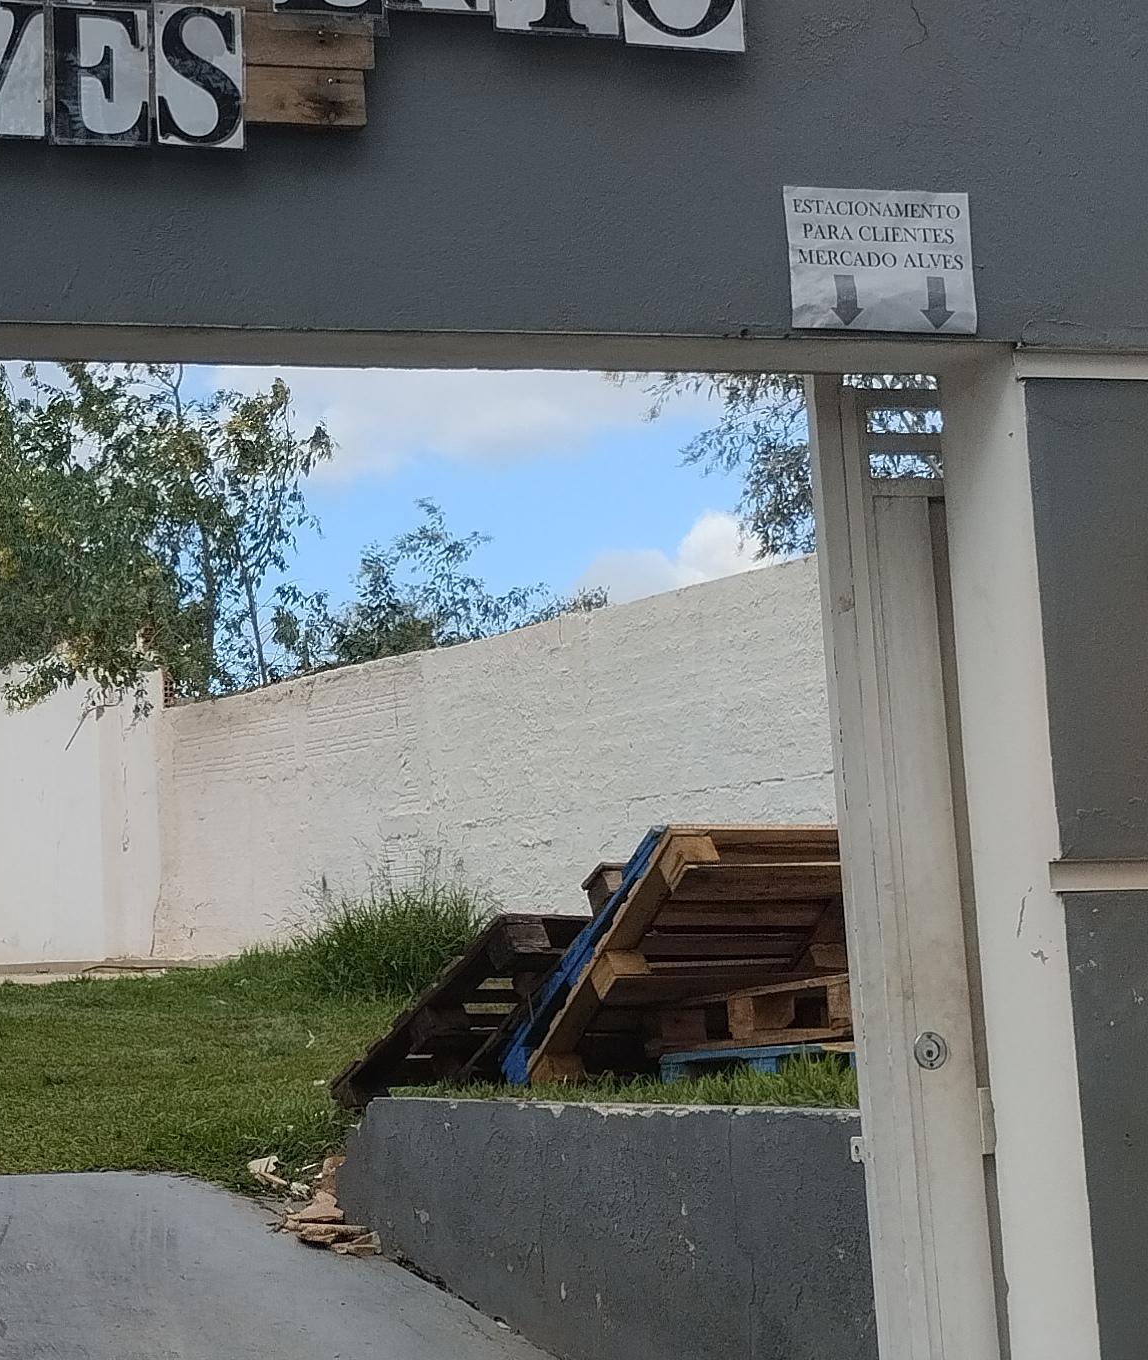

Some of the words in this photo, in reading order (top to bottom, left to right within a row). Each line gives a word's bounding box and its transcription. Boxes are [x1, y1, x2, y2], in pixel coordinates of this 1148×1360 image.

[792, 198, 961, 220] ESTACIONAMENTO
[802, 223, 853, 241] PARA
[858, 225, 954, 245] CLIENTES
[798, 248, 897, 268] MERCADO
[903, 252, 964, 271] ALVES
